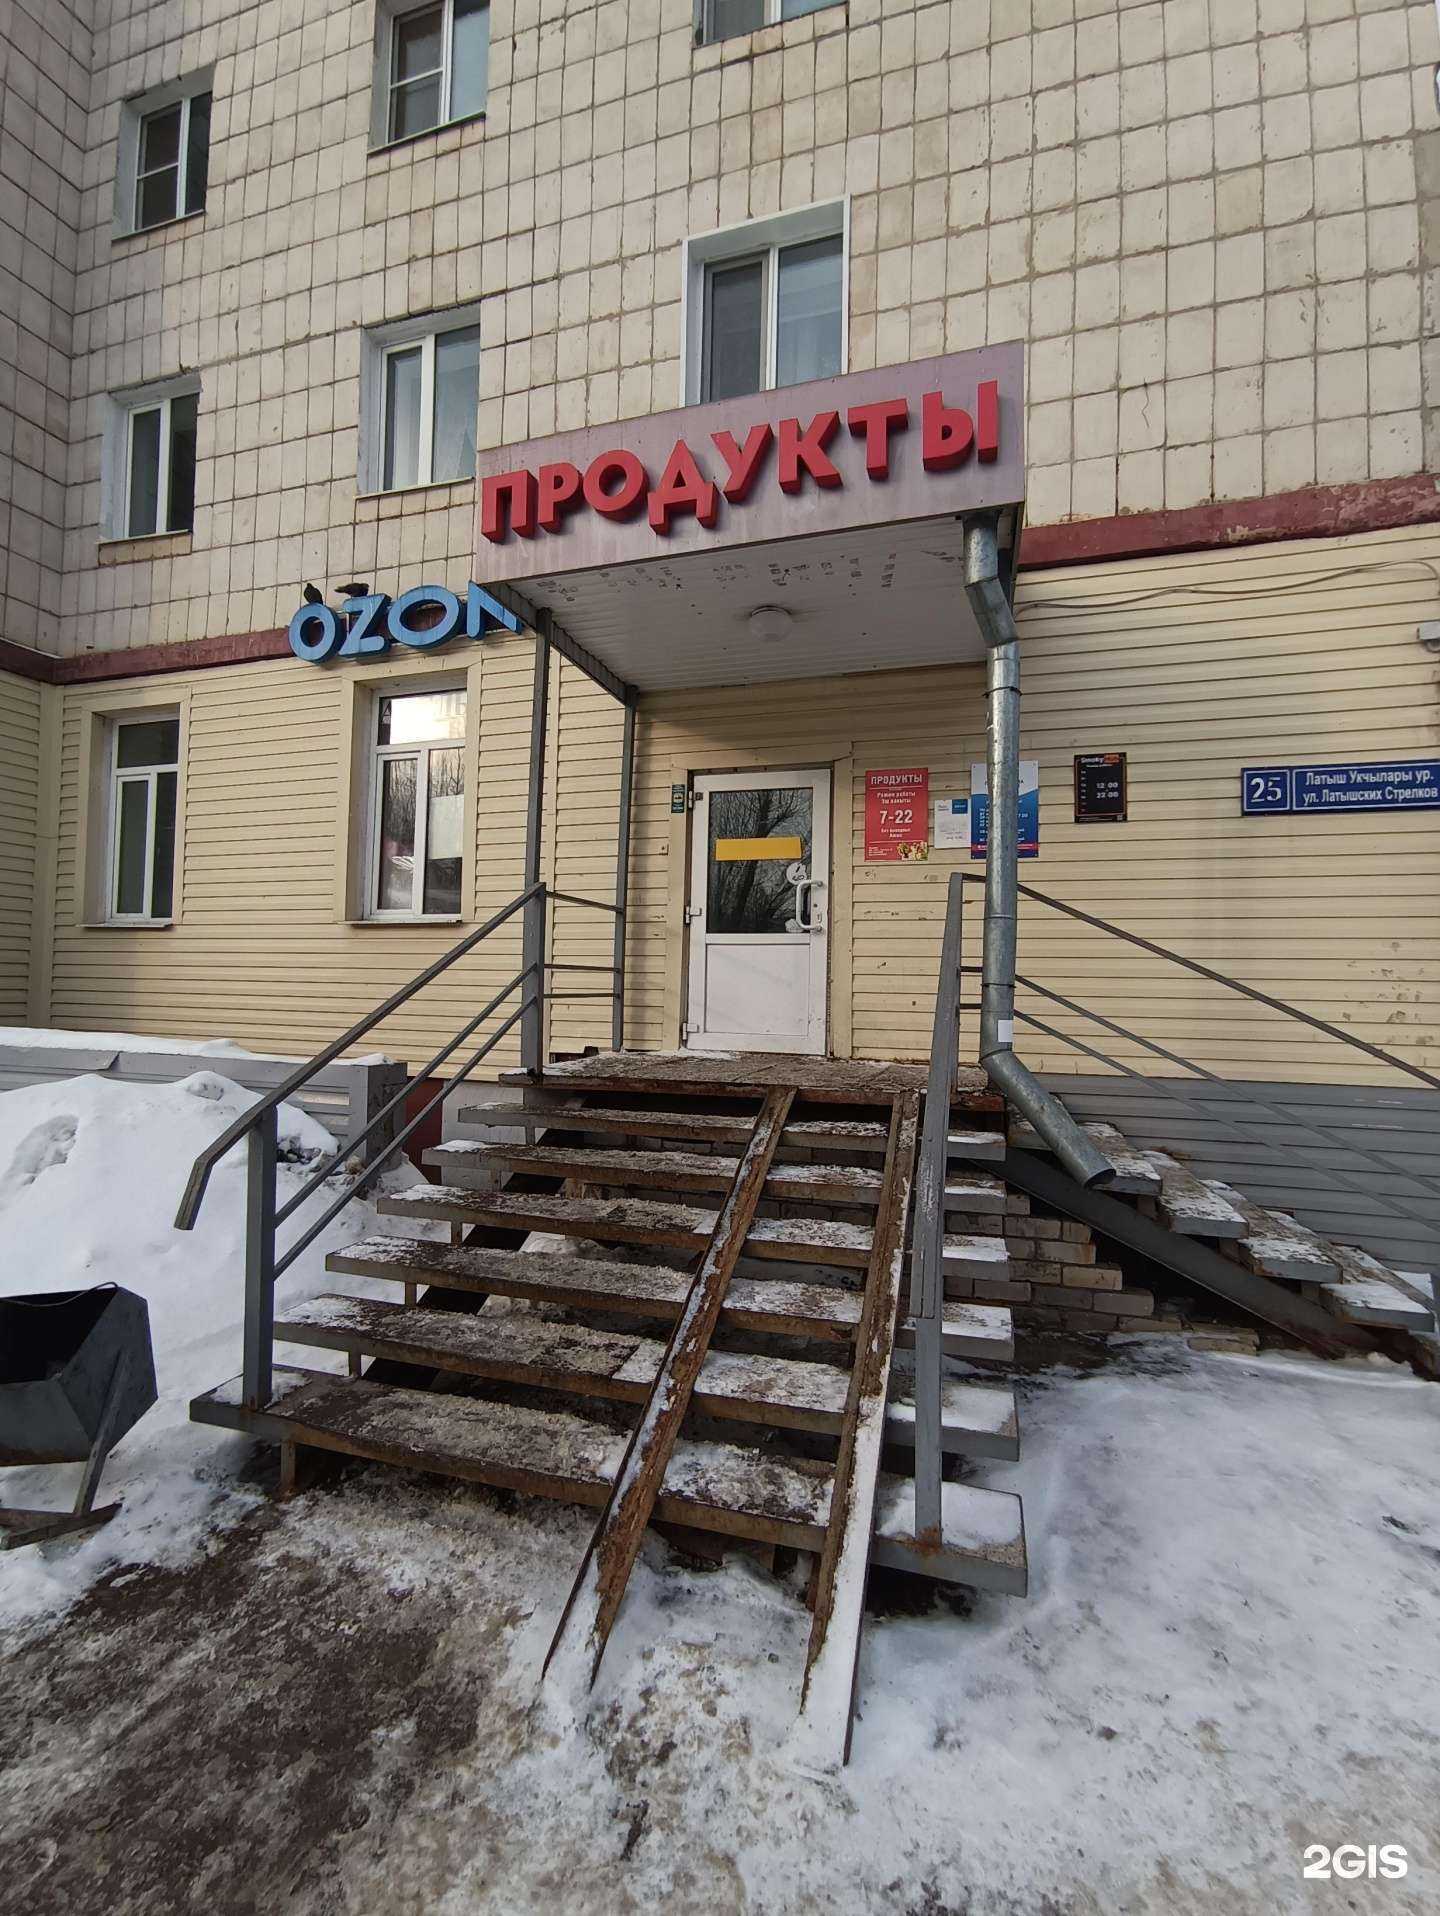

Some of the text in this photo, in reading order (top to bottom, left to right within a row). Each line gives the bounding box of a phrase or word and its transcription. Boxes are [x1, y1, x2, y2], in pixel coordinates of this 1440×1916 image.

[480, 380, 999, 544] ПРОДУКТЫ
[871, 775, 922, 786] ПРОДУКТЫ
[1305, 772, 1347, 785] Латыш
[1415, 769, 1434, 782] ур.
[1250, 777, 1282, 802] 25
[1303, 786, 1438, 806] ул. Латышских Стрелков
[880, 809, 913, 825] 7-22
